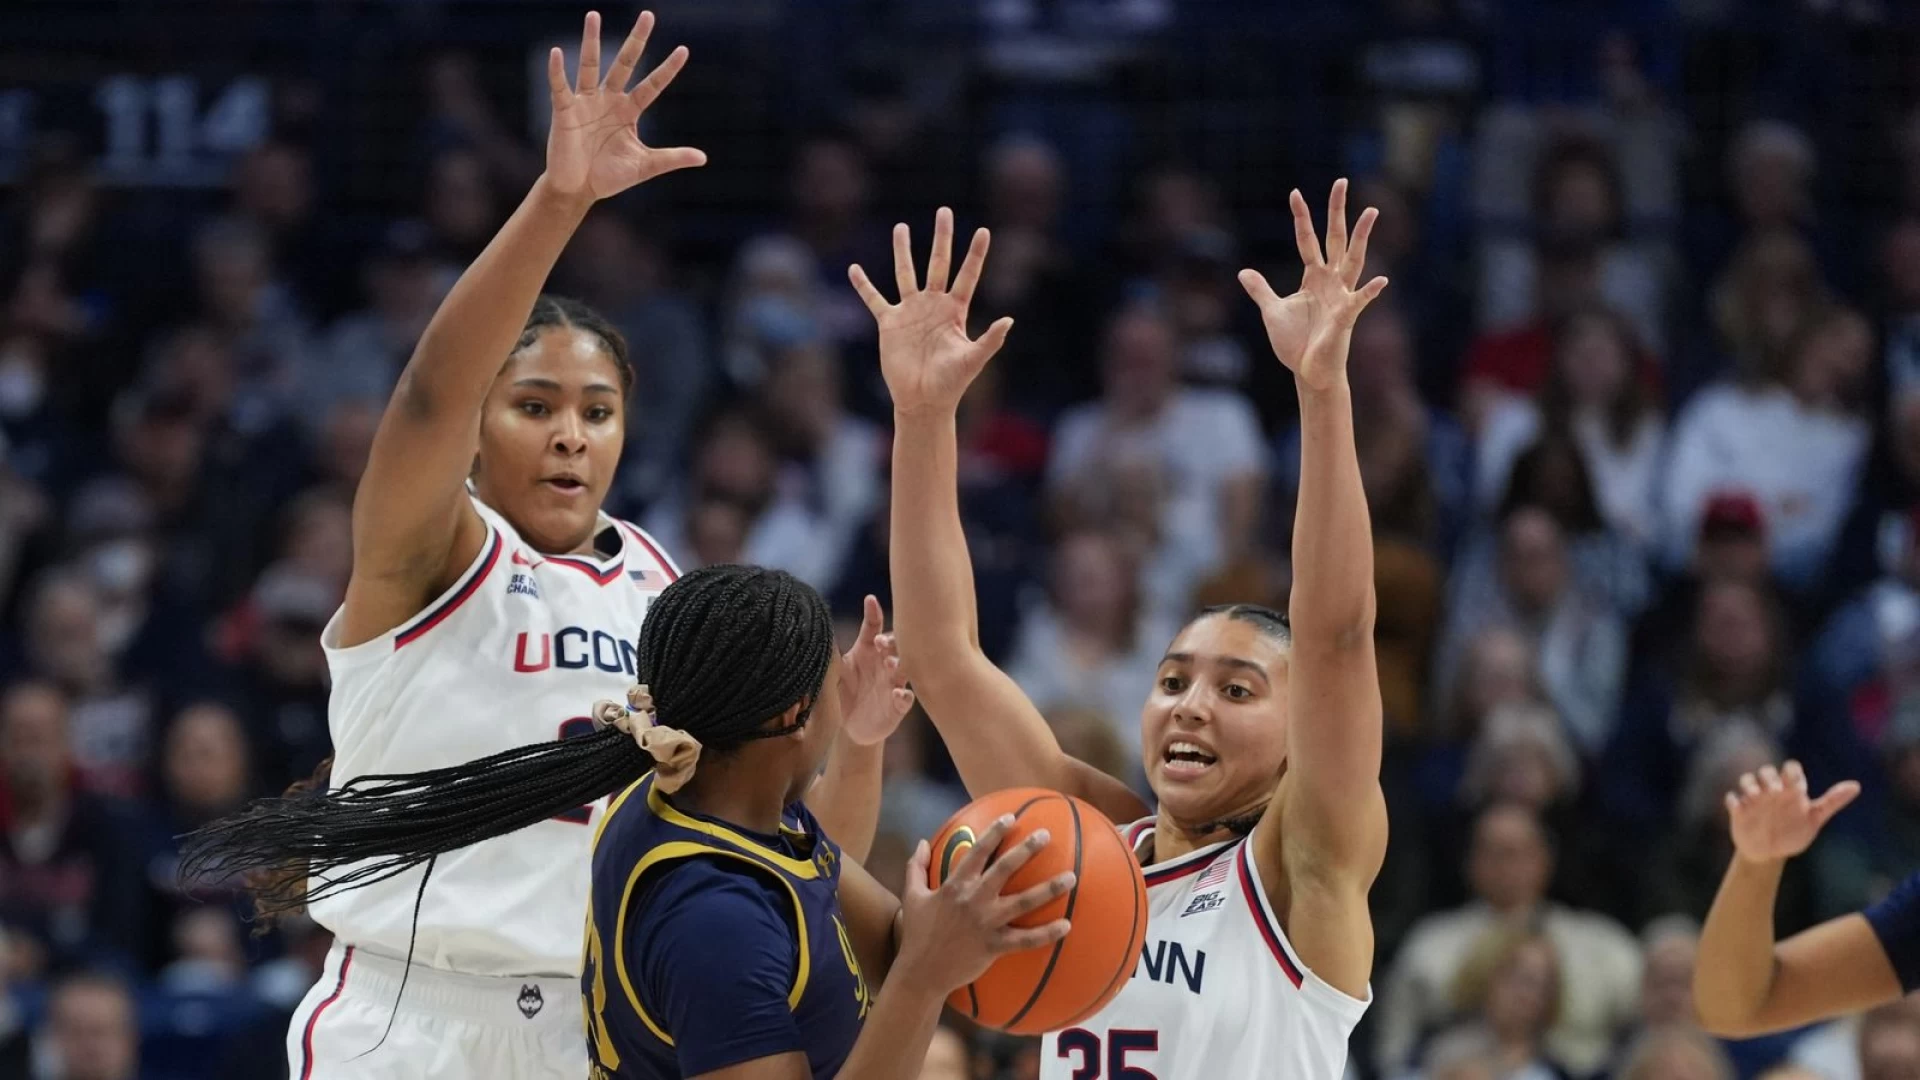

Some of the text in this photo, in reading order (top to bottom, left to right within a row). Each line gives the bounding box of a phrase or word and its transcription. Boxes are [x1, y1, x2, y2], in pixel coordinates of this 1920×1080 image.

[97, 74, 271, 172] 114
[511, 574, 526, 583] BE
[1184, 897, 1226, 913] EAST
[1191, 890, 1221, 905] BIG
[1057, 1027, 1160, 1080] 35
